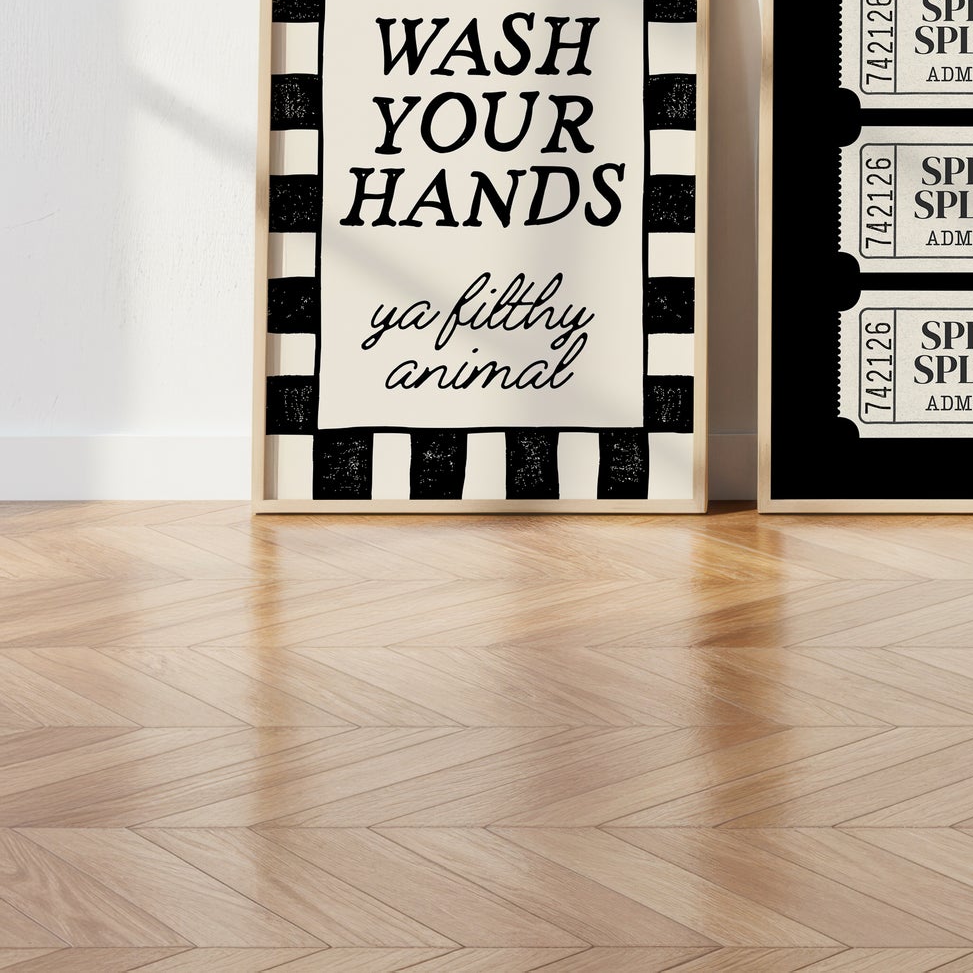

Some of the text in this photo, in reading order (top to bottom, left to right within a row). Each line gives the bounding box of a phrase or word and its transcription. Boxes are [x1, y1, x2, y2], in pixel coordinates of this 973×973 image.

[375, 11, 600, 76] WASH
[372, 90, 594, 155] YOUR
[339, 162, 625, 228] HANDS
[865, 157, 893, 248] 742126
[360, 271, 595, 353] ya filthy
[384, 331, 588, 389] animal
[864, 322, 892, 414] 742126
